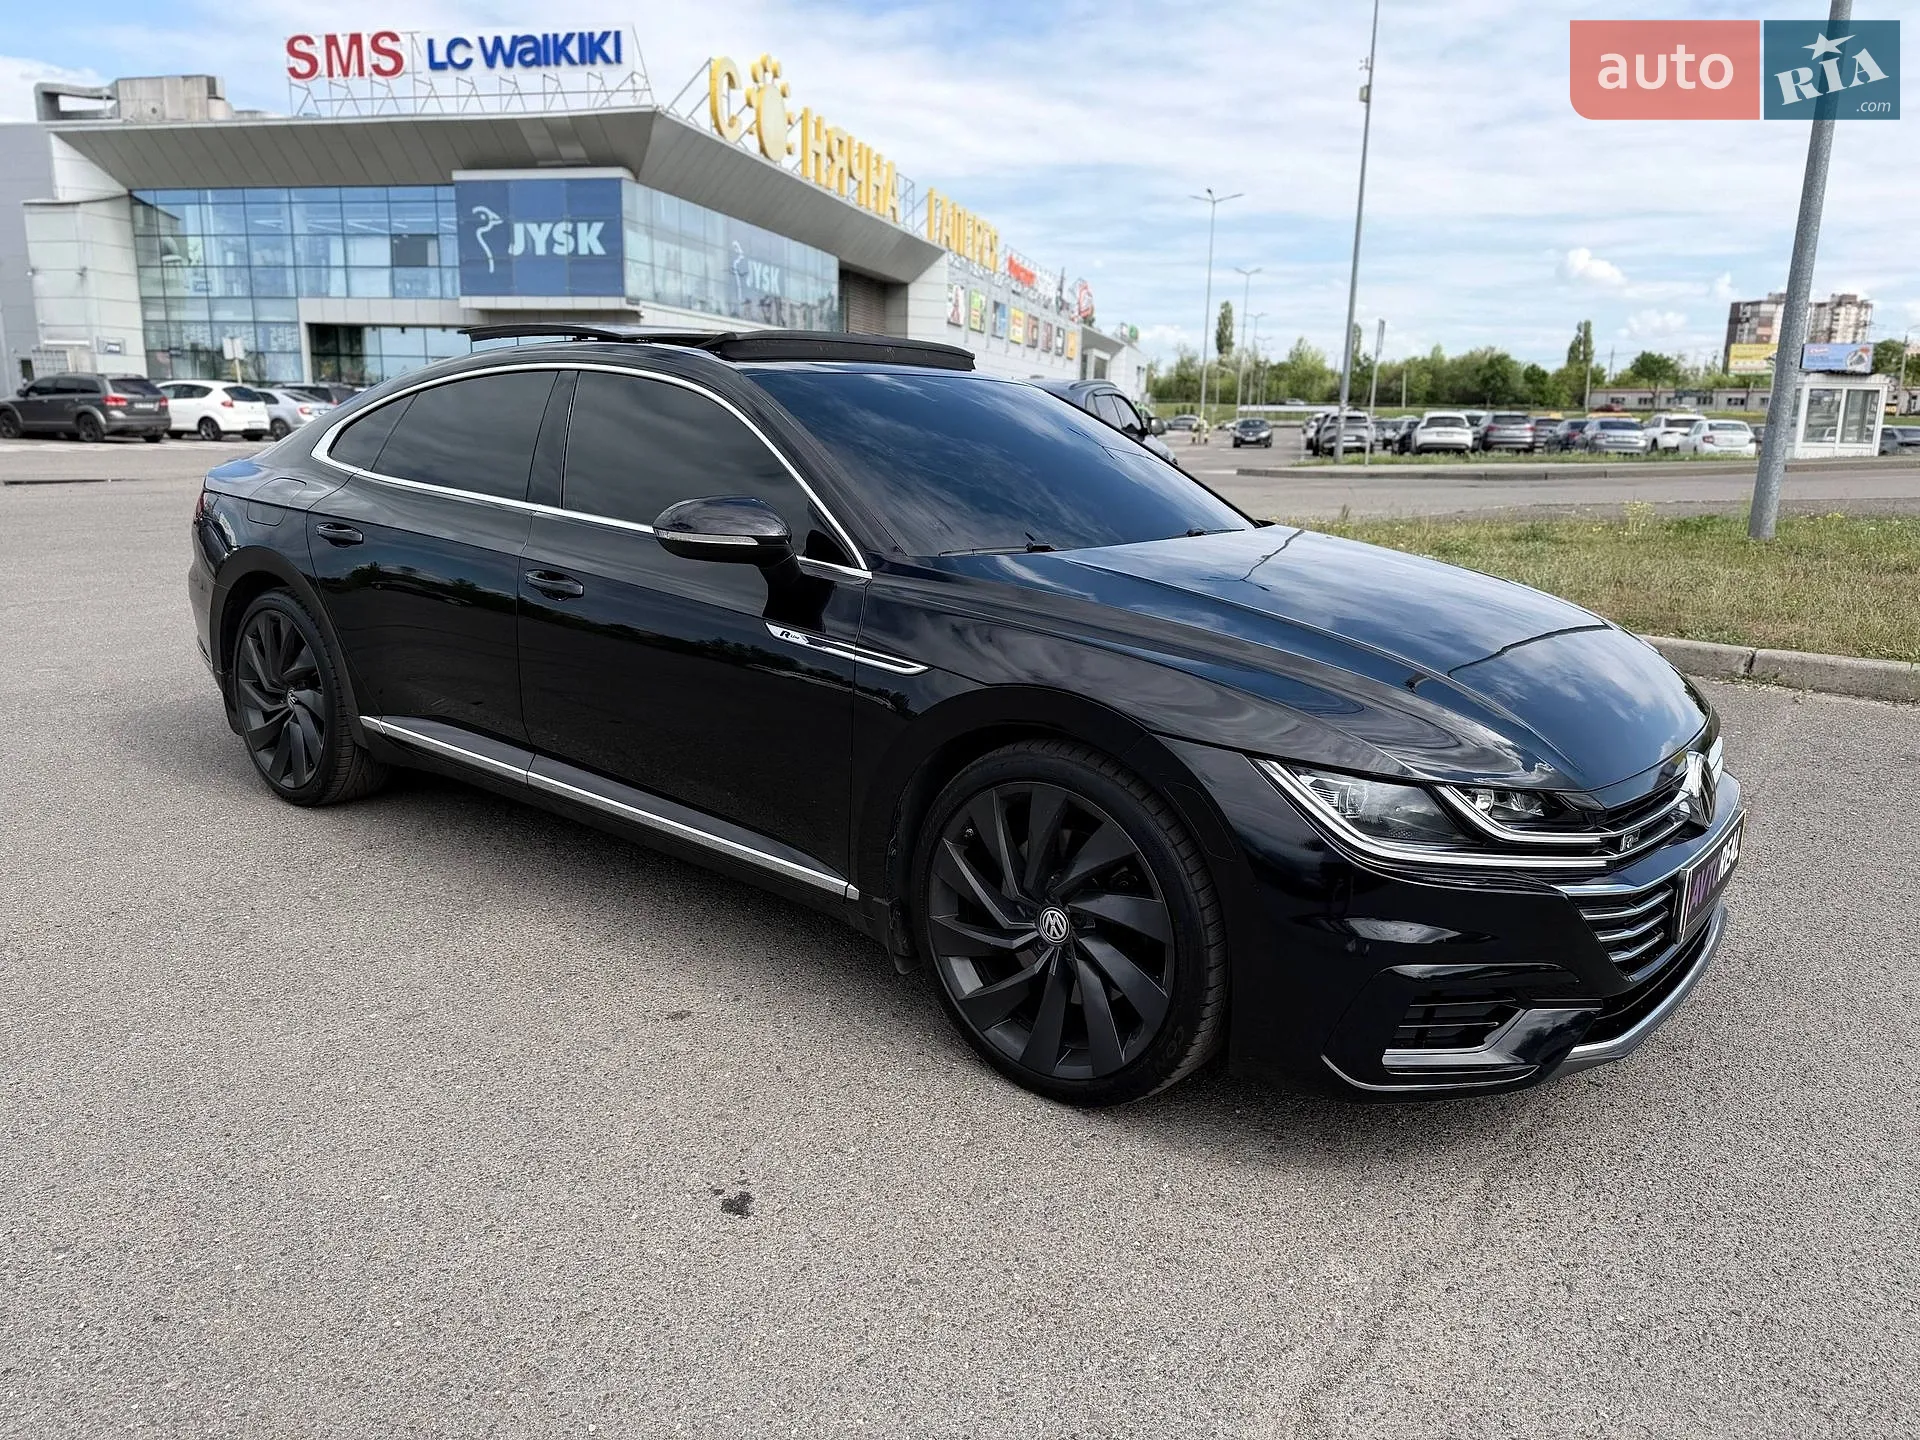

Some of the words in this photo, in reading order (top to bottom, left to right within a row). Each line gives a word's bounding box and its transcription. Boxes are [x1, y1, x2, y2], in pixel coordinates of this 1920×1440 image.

[286, 31, 404, 80] SMS
[427, 37, 473, 71] LC
[709, 53, 900, 225] СОНЯЧНА
[508, 221, 606, 256] JYSK
[746, 260, 780, 294] JYSK
